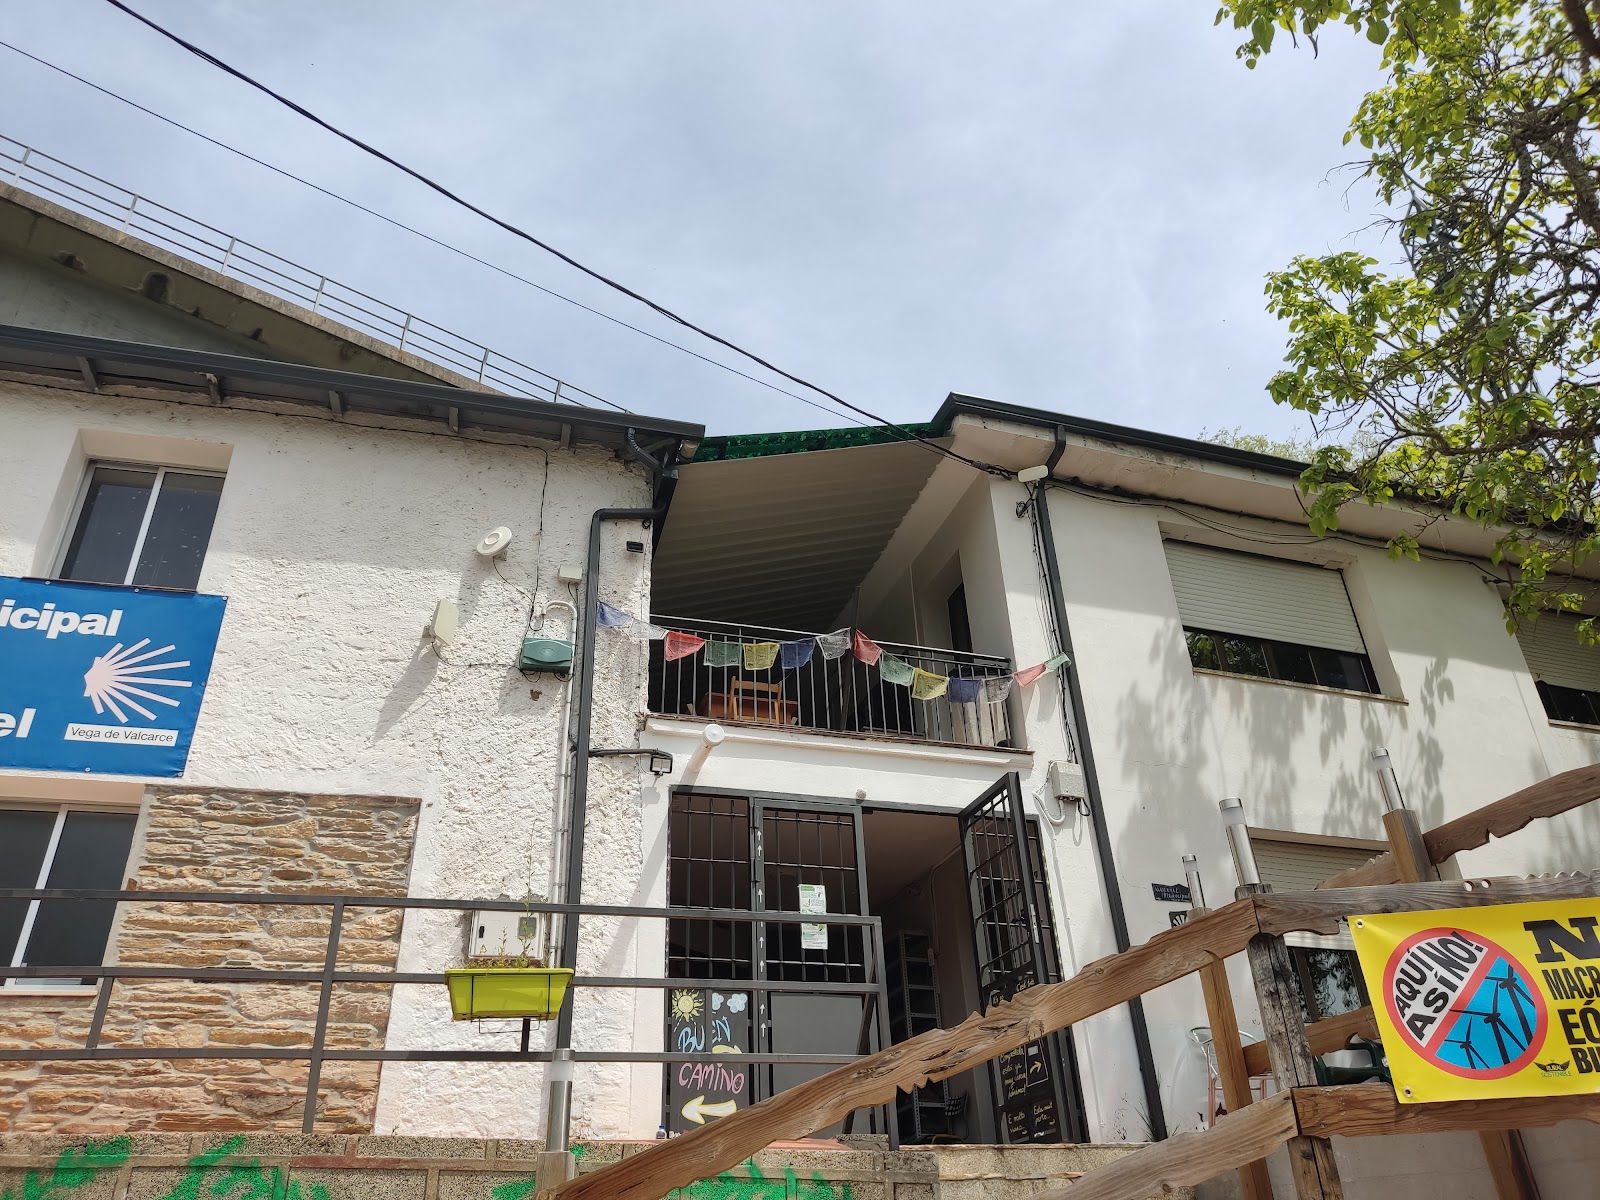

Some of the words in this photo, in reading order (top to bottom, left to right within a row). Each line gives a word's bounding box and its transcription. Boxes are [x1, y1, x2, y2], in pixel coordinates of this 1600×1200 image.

[71, 726, 101, 740] Vega
[104, 729, 120, 739] de
[124, 730, 174, 742] Valcarce
[1395, 947, 1435, 1019] AQUÍ
[1415, 930, 1484, 982] NO!
[1406, 970, 1459, 1041] ASÍ
[677, 1015, 731, 1054] BUN
[678, 1062, 745, 1095] CAMINO
